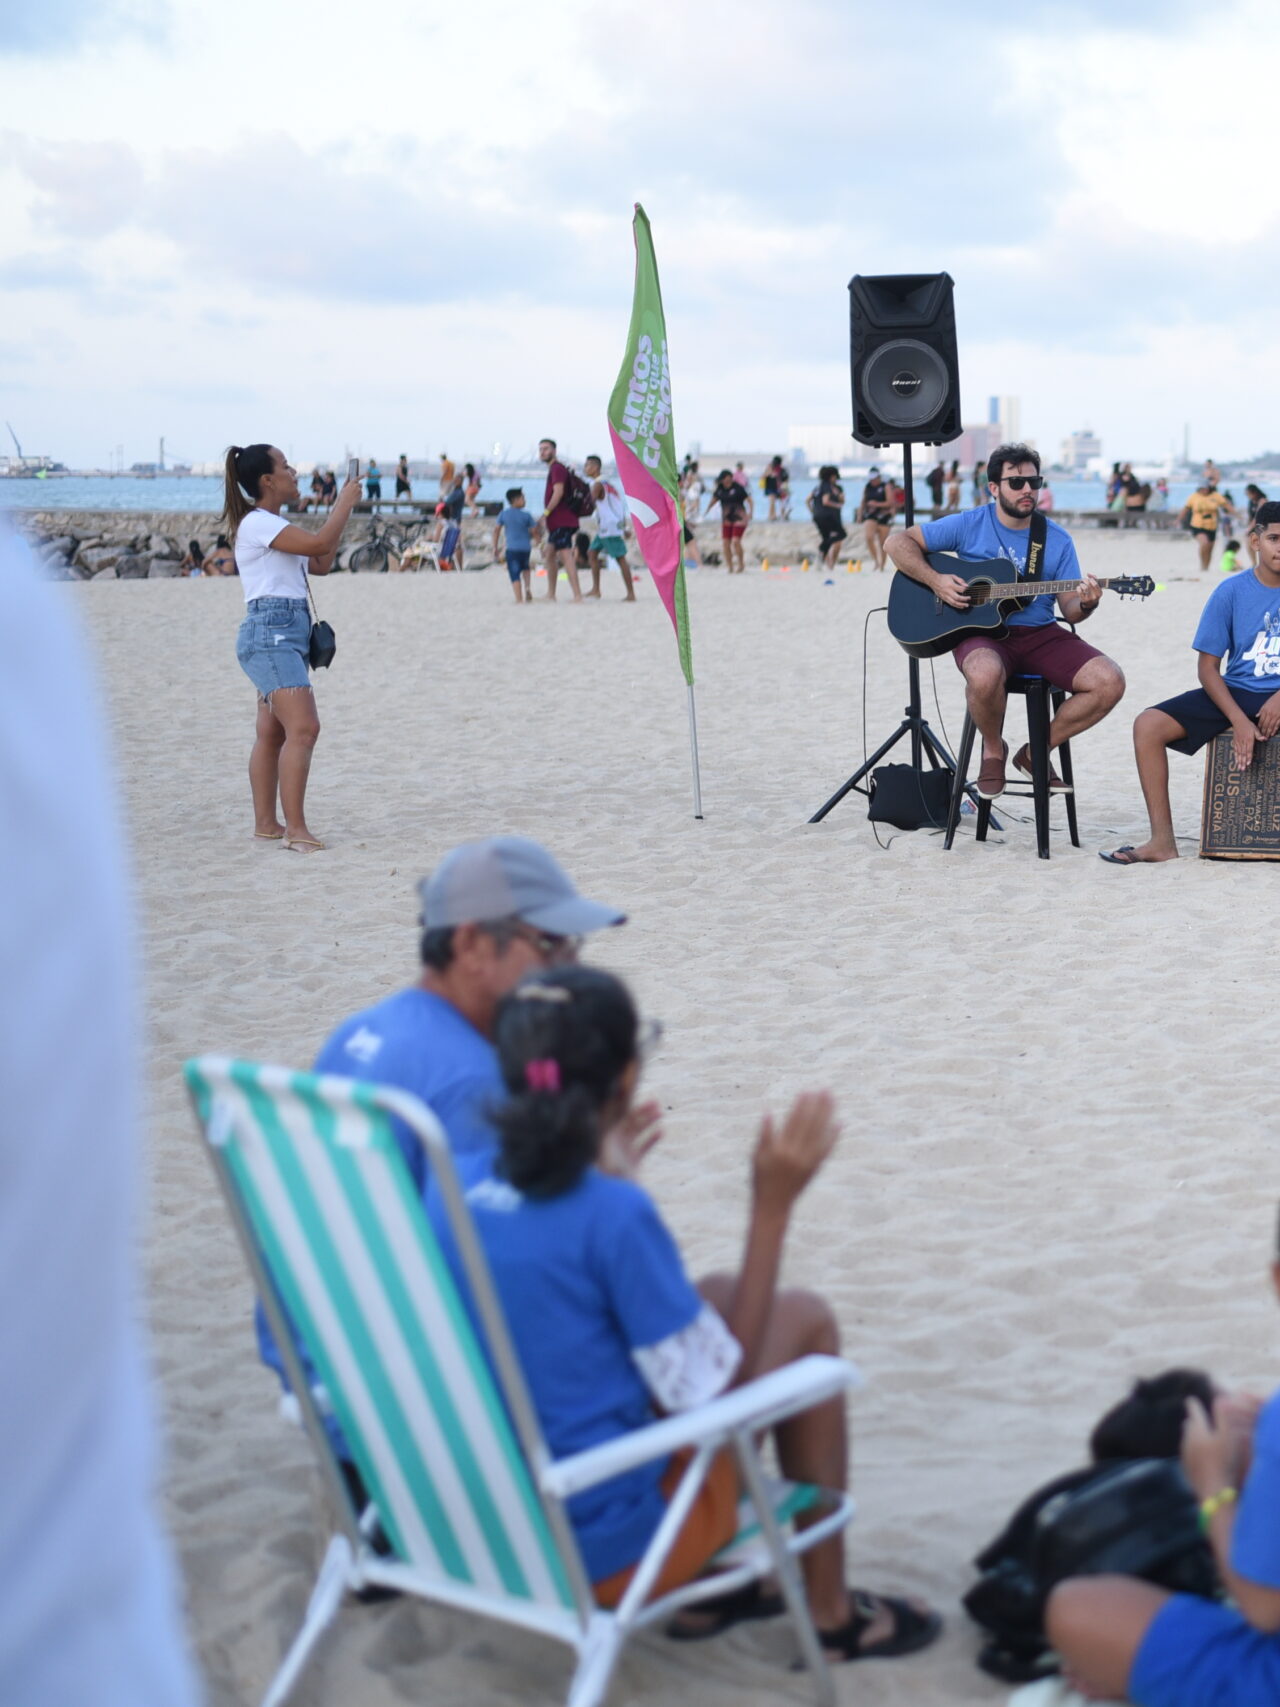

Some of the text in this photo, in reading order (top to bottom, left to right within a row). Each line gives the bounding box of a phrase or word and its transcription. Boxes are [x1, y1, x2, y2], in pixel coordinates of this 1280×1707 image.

[638, 352, 660, 438] para que
[1029, 541, 1042, 574] Ibanez
[1215, 741, 1224, 781] SALVAÇÃO
[1213, 784, 1224, 832] GLORIA
[1244, 807, 1254, 831] PAZ
[1254, 790, 1262, 832] SALVAÇÃO
[1272, 806, 1280, 831] LUZ
